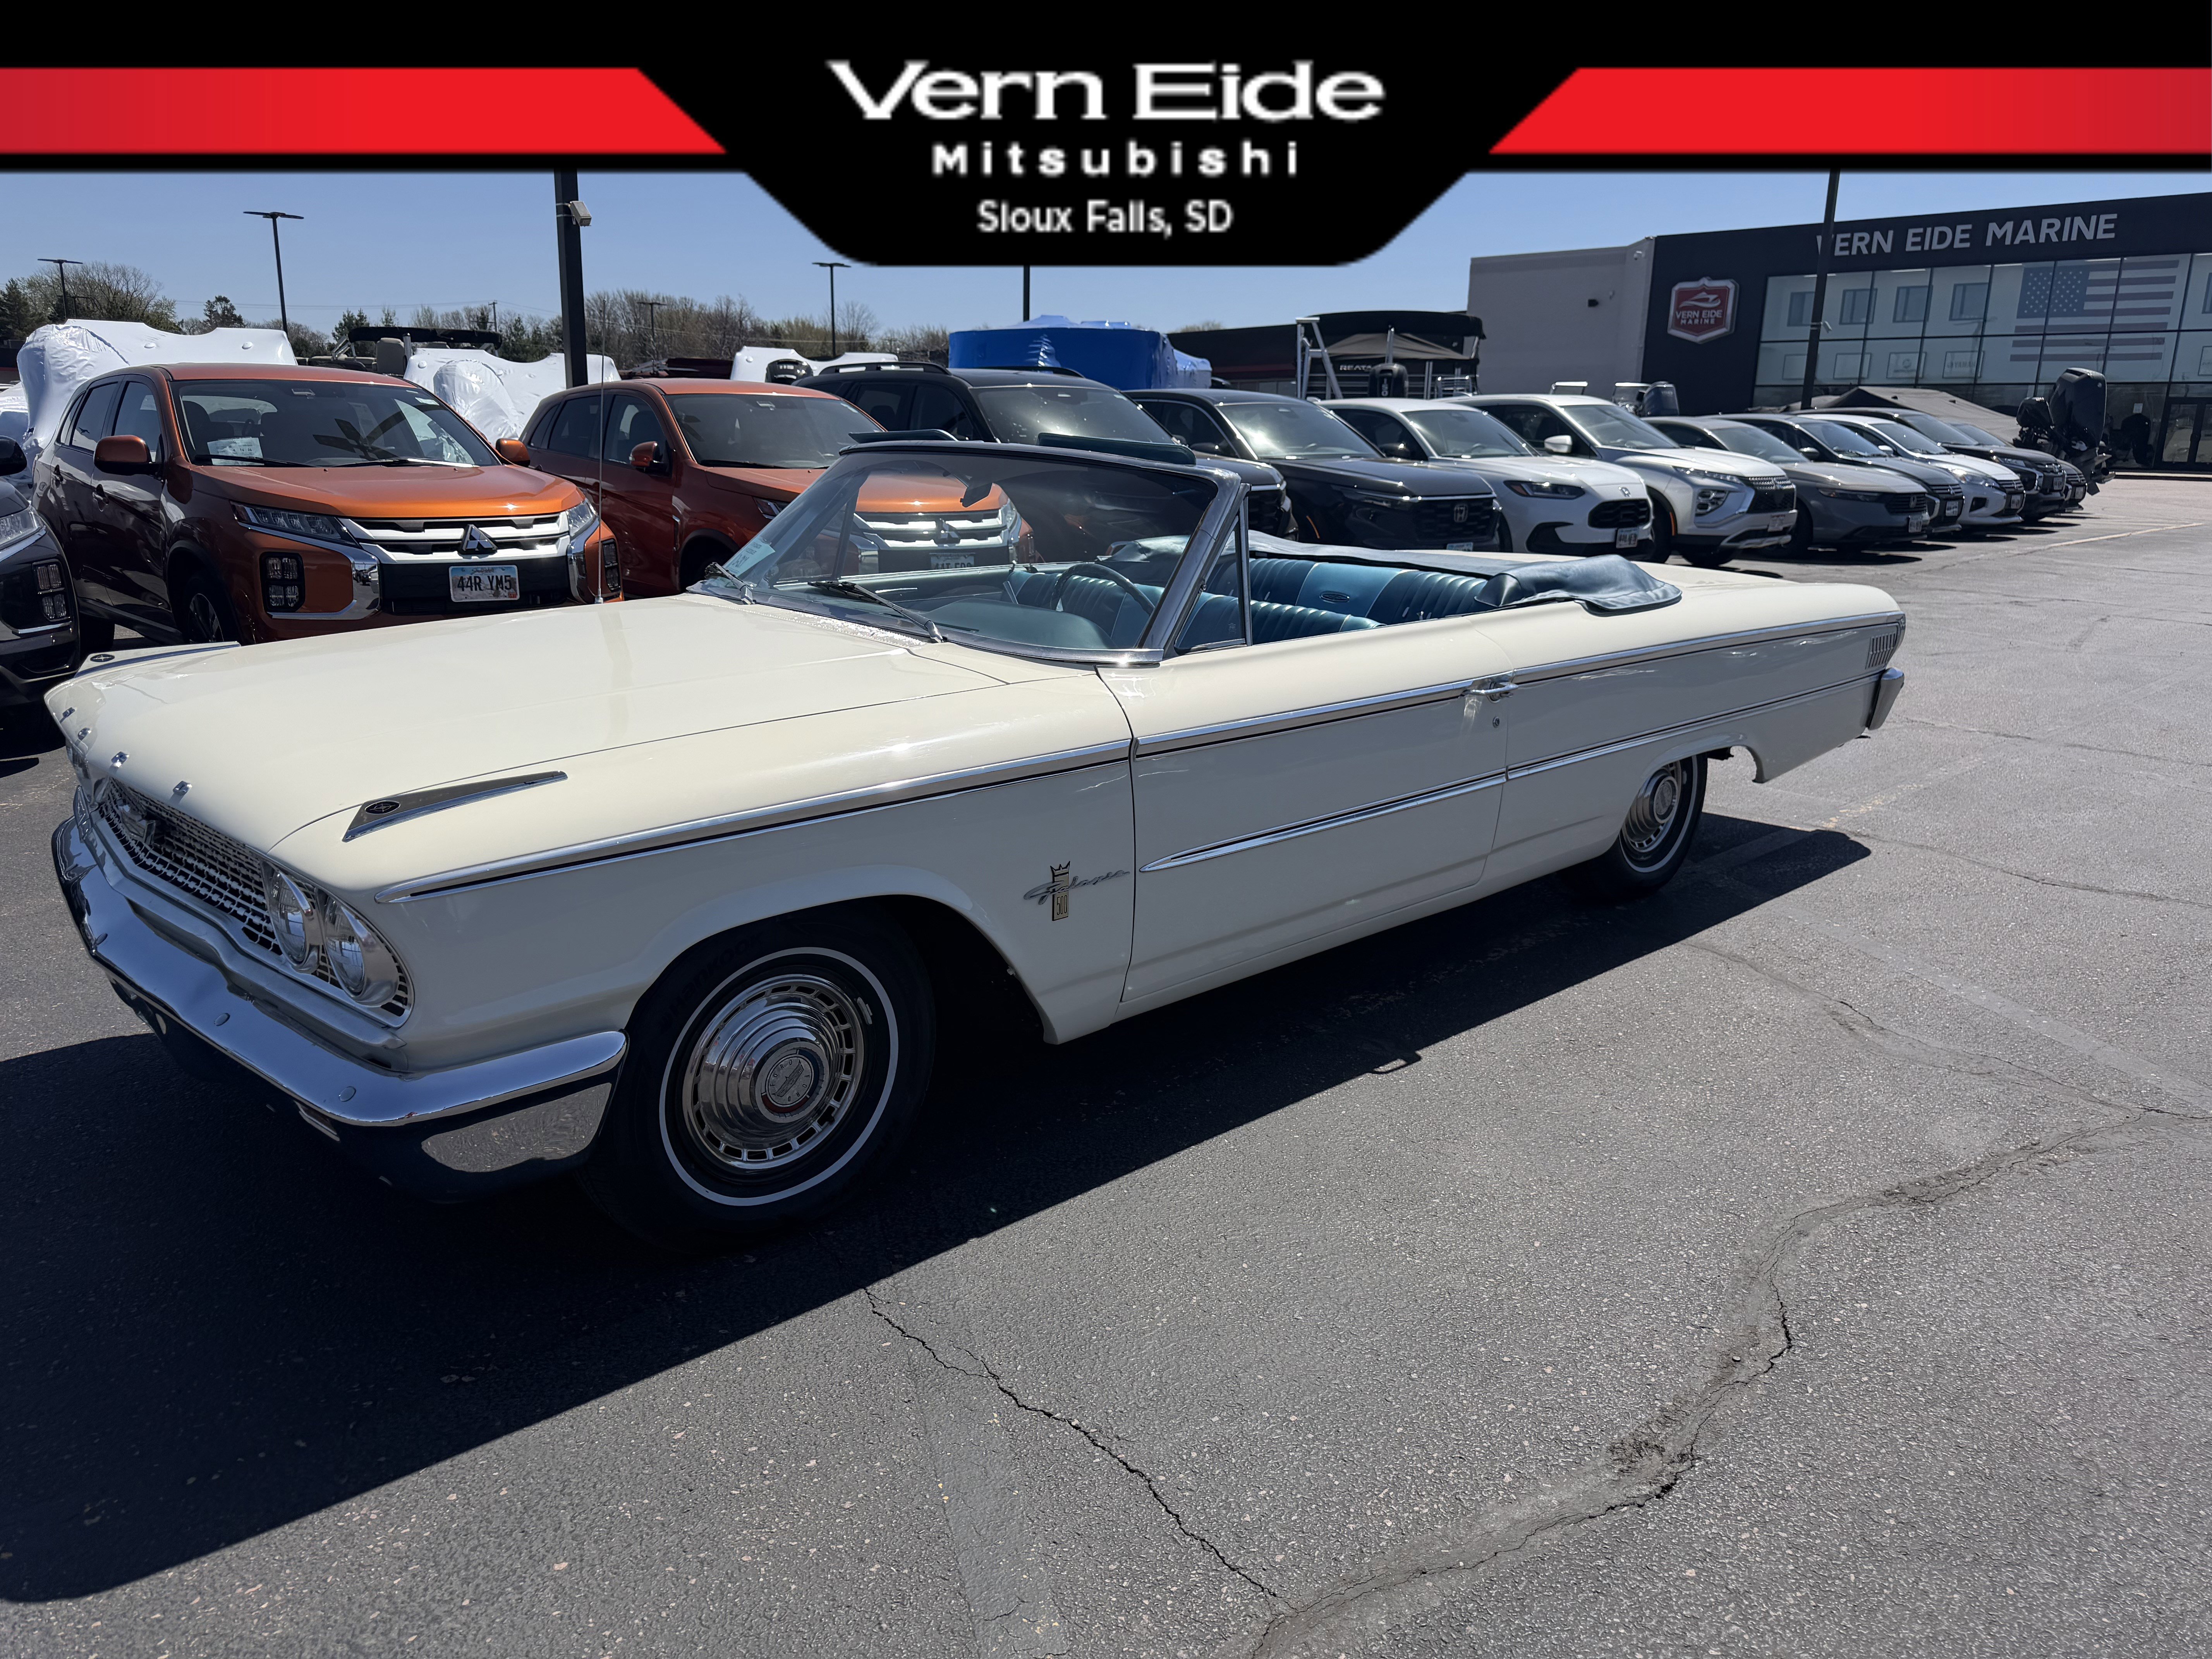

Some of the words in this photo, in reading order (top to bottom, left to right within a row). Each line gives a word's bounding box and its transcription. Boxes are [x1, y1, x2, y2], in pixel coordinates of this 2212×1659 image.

[1906, 224, 1972, 251] EIDE
[1985, 214, 2118, 246] MARINE
[1675, 310, 1700, 319] VERN
[1702, 309, 1723, 318] EIDE
[457, 576, 483, 591] 44R
[487, 575, 512, 591] YM5
[1056, 895, 1068, 915] 500
[770, 1059, 792, 1086] FORD
